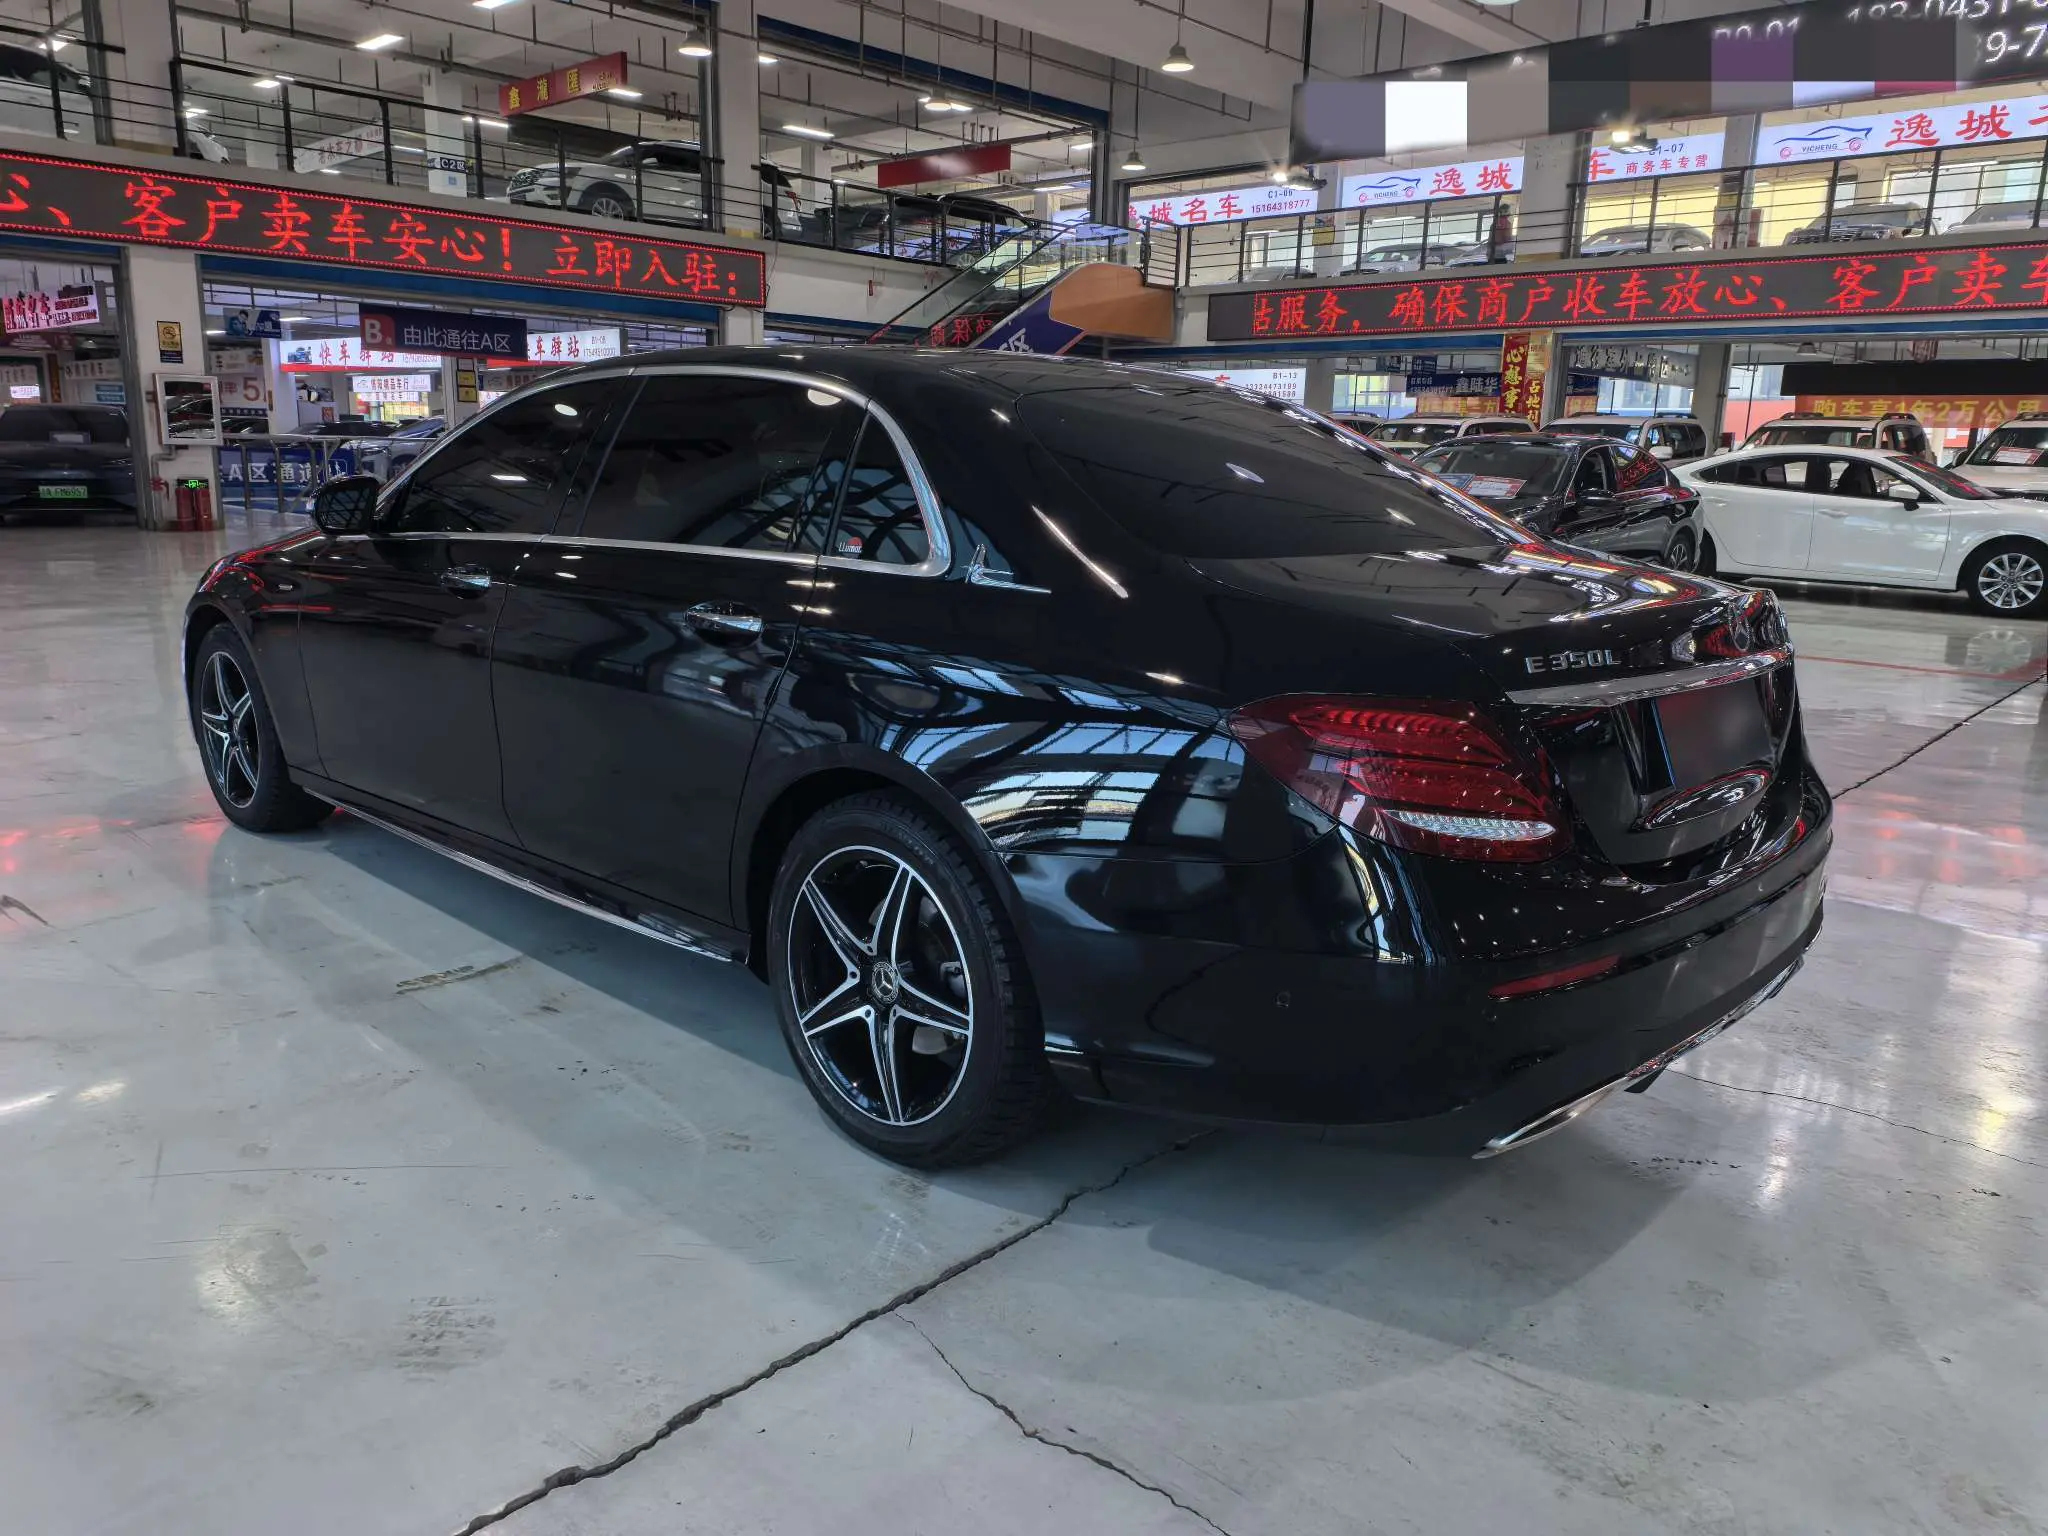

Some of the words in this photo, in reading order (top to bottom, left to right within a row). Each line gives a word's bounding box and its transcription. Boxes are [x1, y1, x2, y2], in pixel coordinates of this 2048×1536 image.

[1802, 143, 1838, 153] YICHENG
[1626, 154, 1708, 175] 商务车专营
[1429, 161, 1514, 196] 逸城
[403, 326, 512, 353] 由此通往A区
[527, 334, 580, 360] 车驿站
[1504, 346, 1528, 414] 心想事
[220, 462, 319, 483] A区通道
